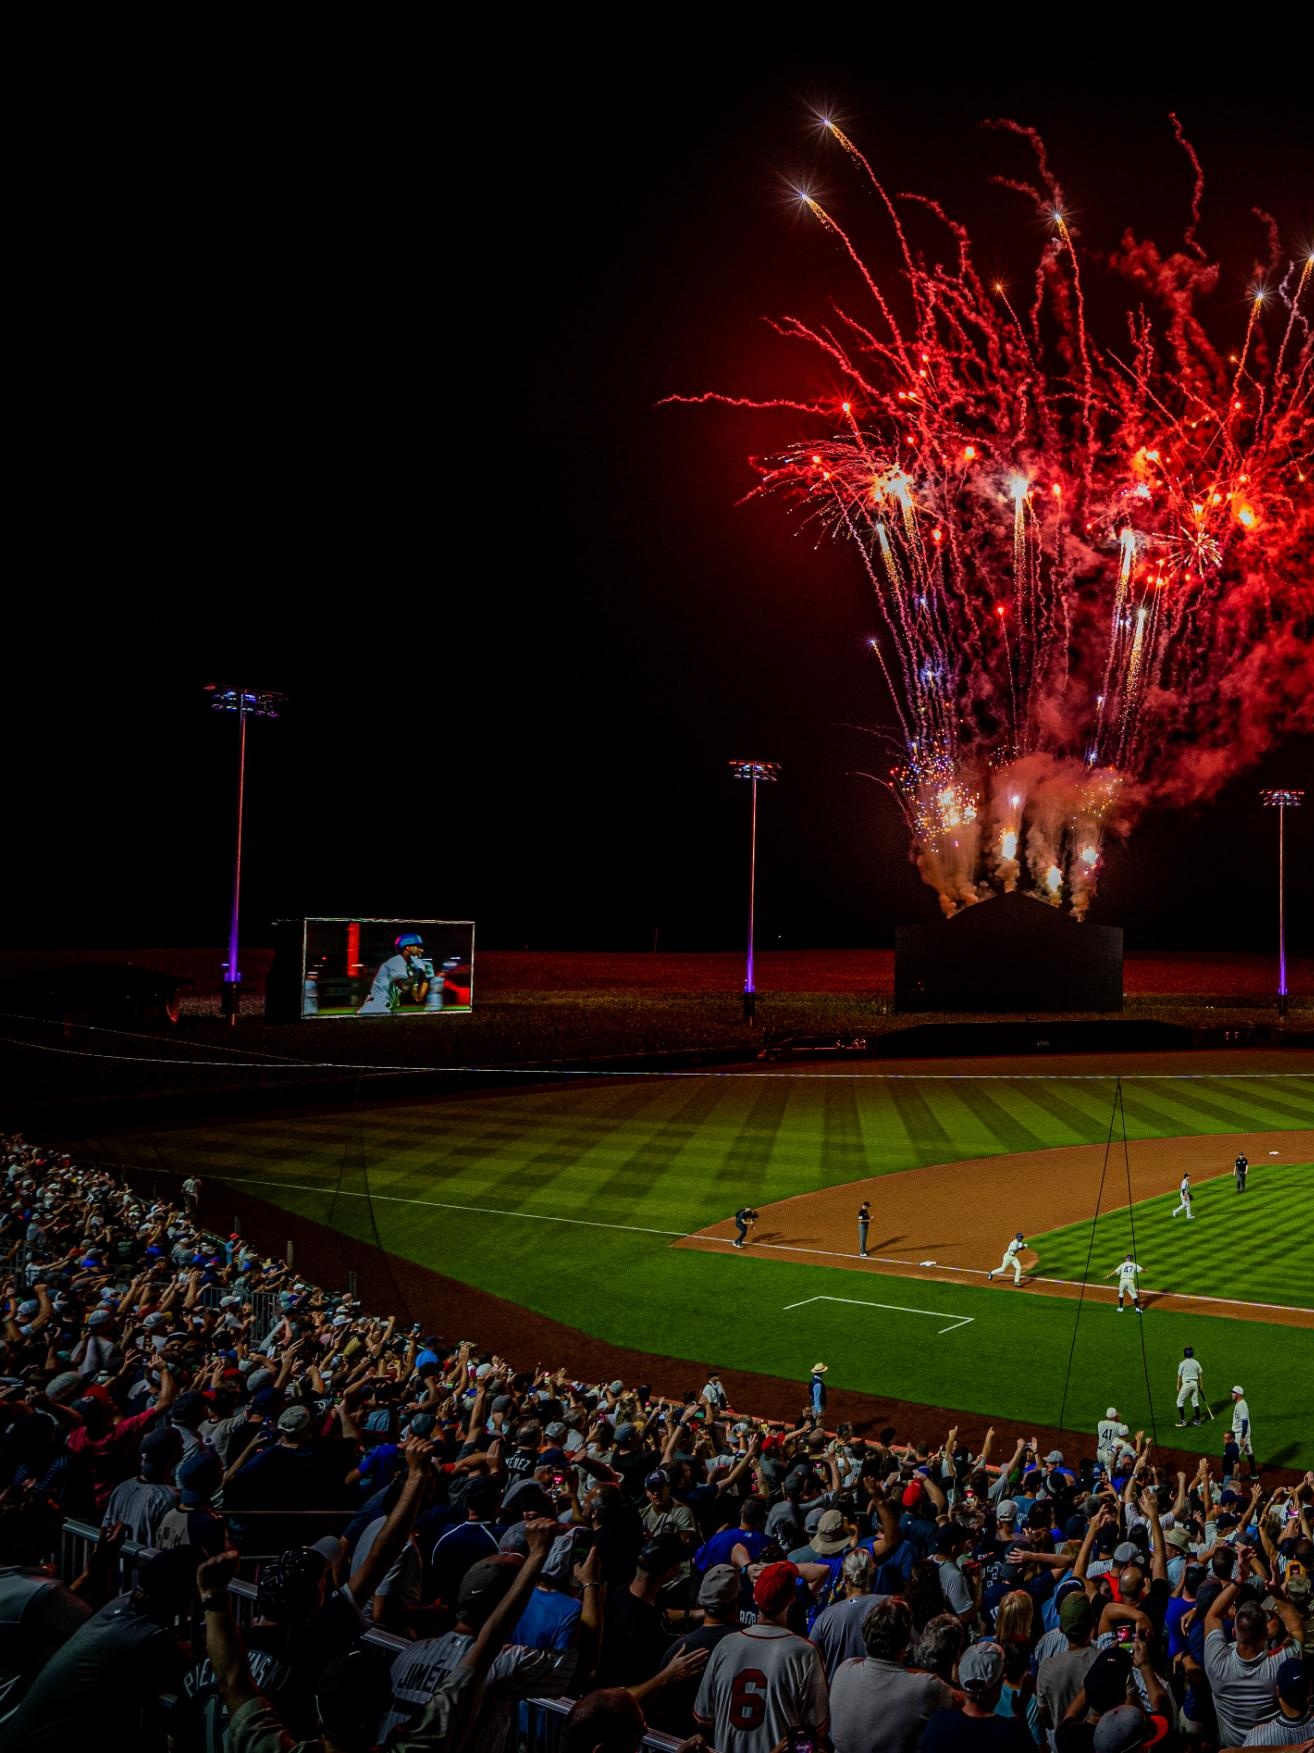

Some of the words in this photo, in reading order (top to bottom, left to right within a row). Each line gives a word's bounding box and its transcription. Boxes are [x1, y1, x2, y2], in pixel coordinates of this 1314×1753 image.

[1123, 1265, 1134, 1274] 47
[1102, 1428, 1113, 1440] 41
[397, 1659, 453, 1694] JIMÉN
[729, 1668, 769, 1731] 6
